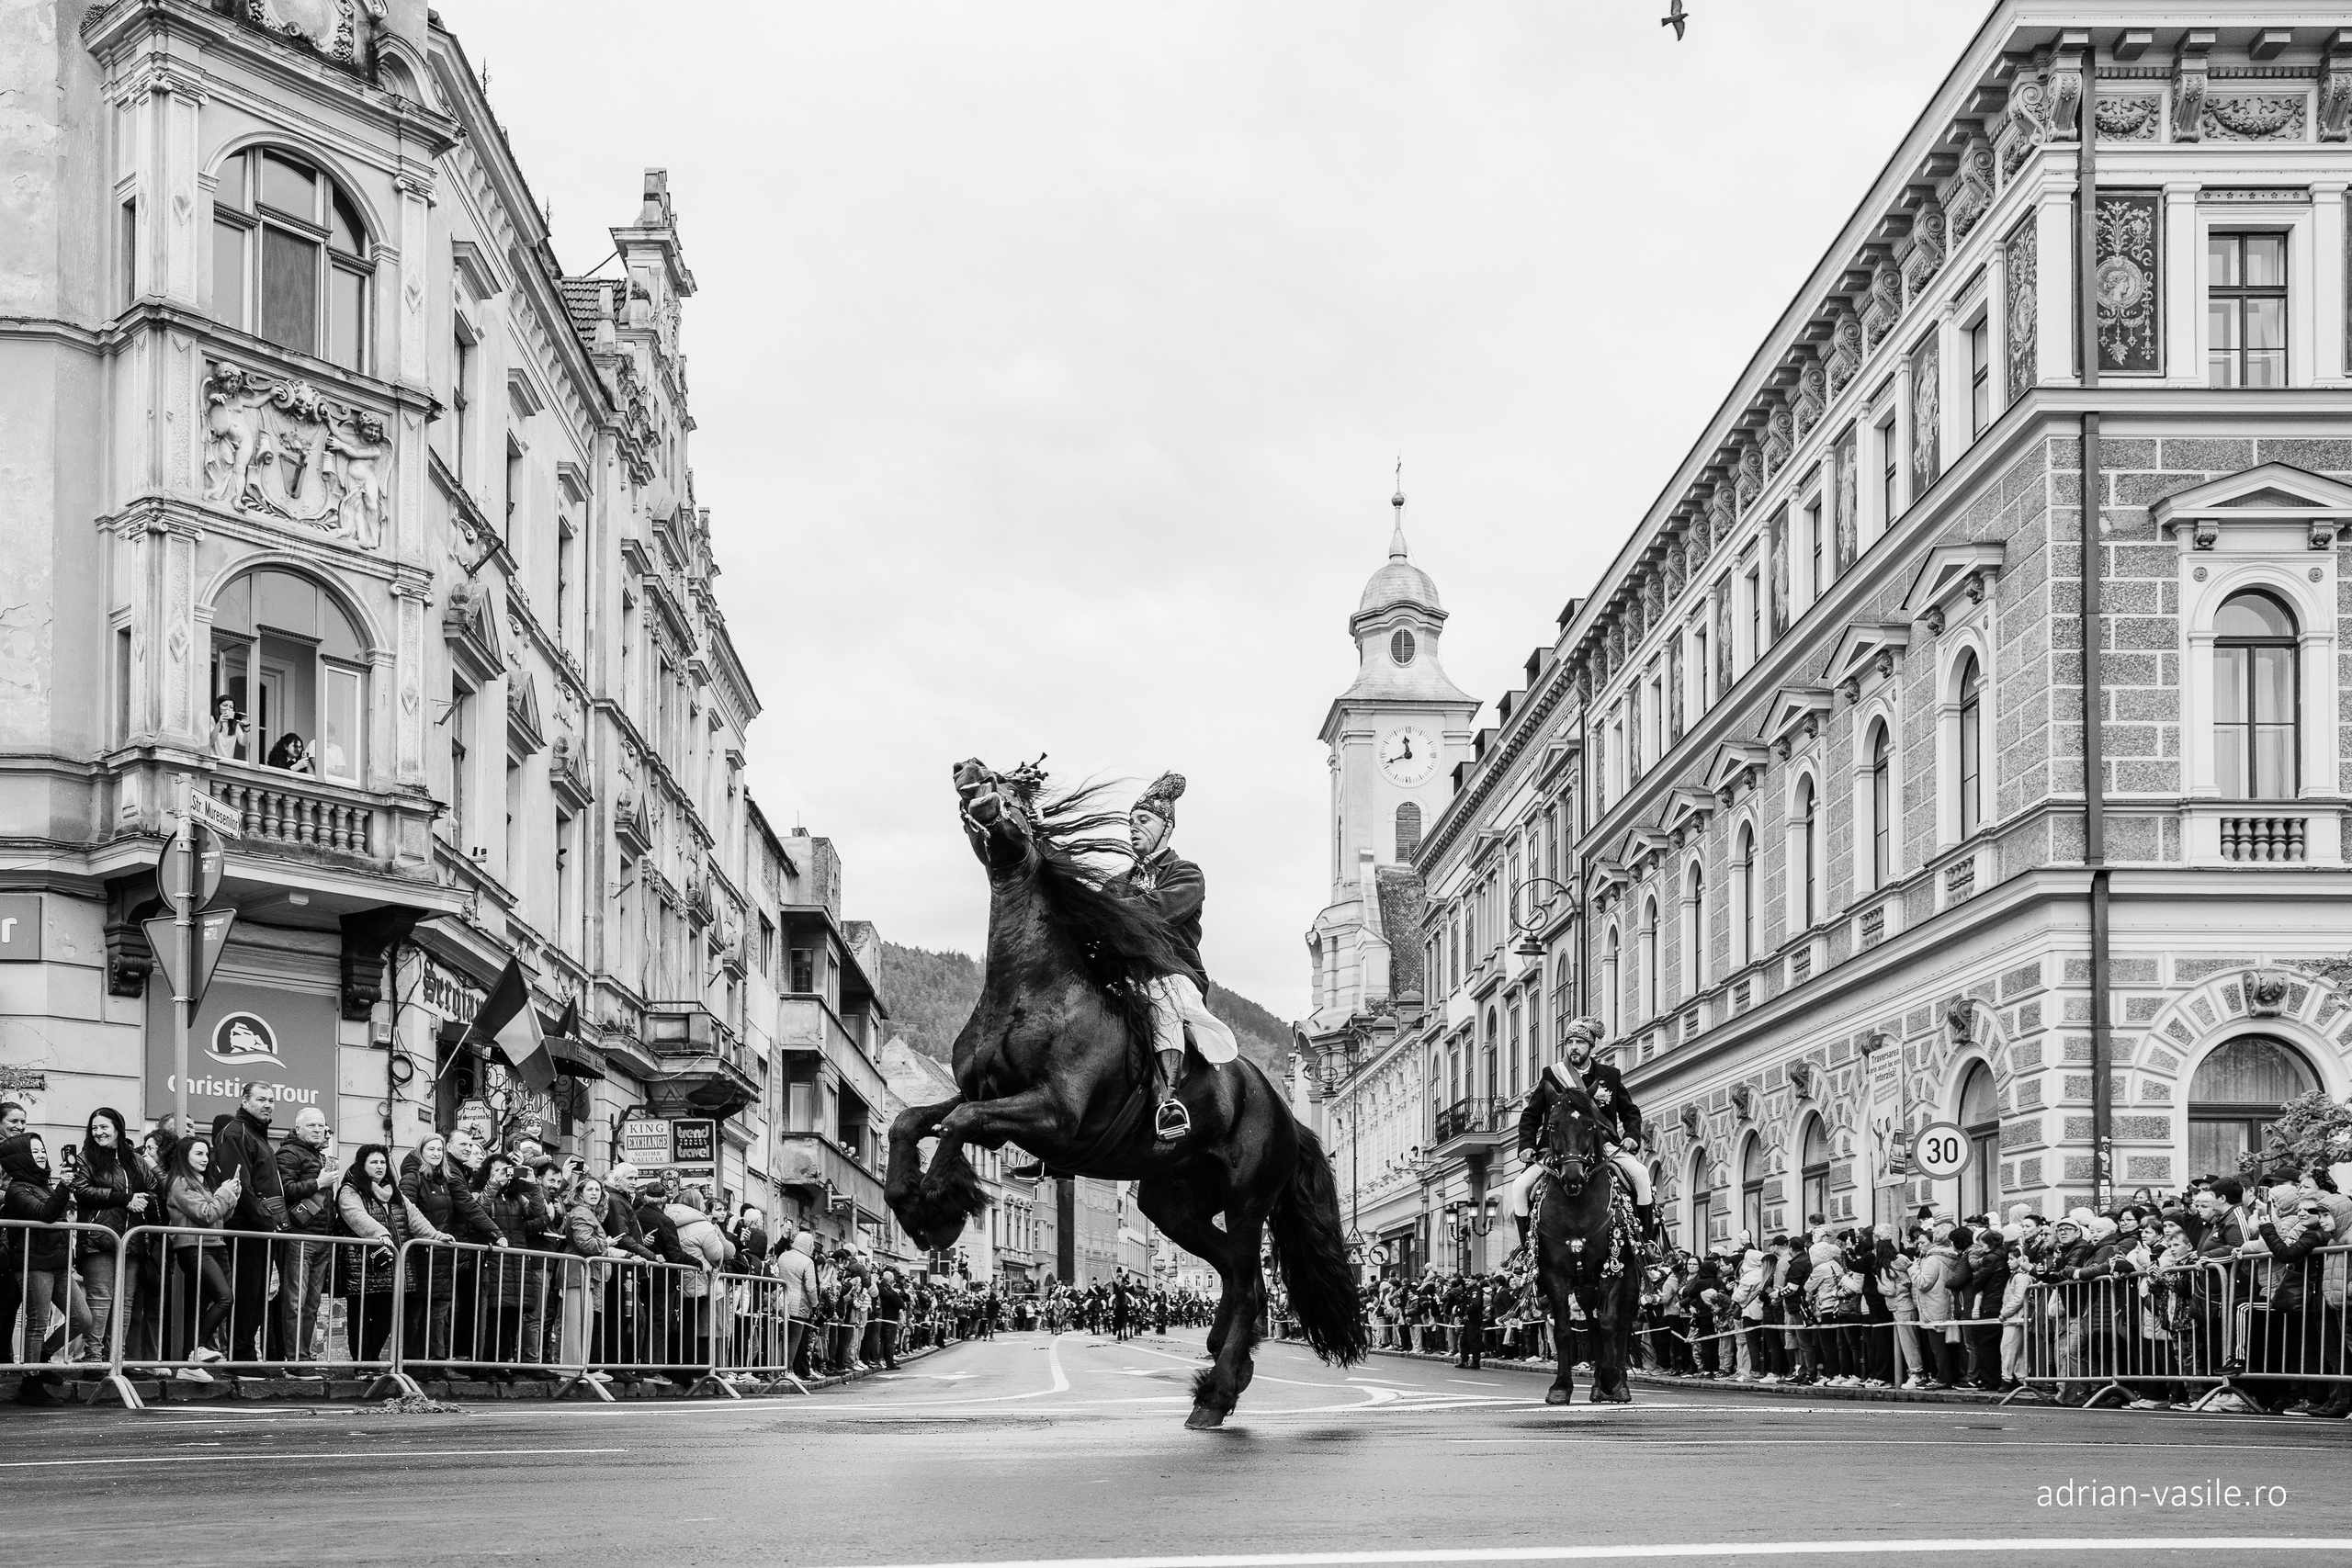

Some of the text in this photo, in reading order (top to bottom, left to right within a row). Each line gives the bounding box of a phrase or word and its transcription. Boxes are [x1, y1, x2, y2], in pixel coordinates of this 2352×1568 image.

[192, 795, 203, 814] Str.
[424, 957, 485, 1024] Sergia
[1871, 1048, 1899, 1064] Traversarea
[167, 1074, 319, 1104] hristi Tour
[629, 1123, 664, 1134] KING
[676, 1125, 710, 1139] trend
[628, 1135, 668, 1149] EXCHANGE
[676, 1145, 710, 1158] travel
[1927, 1137, 1959, 1165] 30
